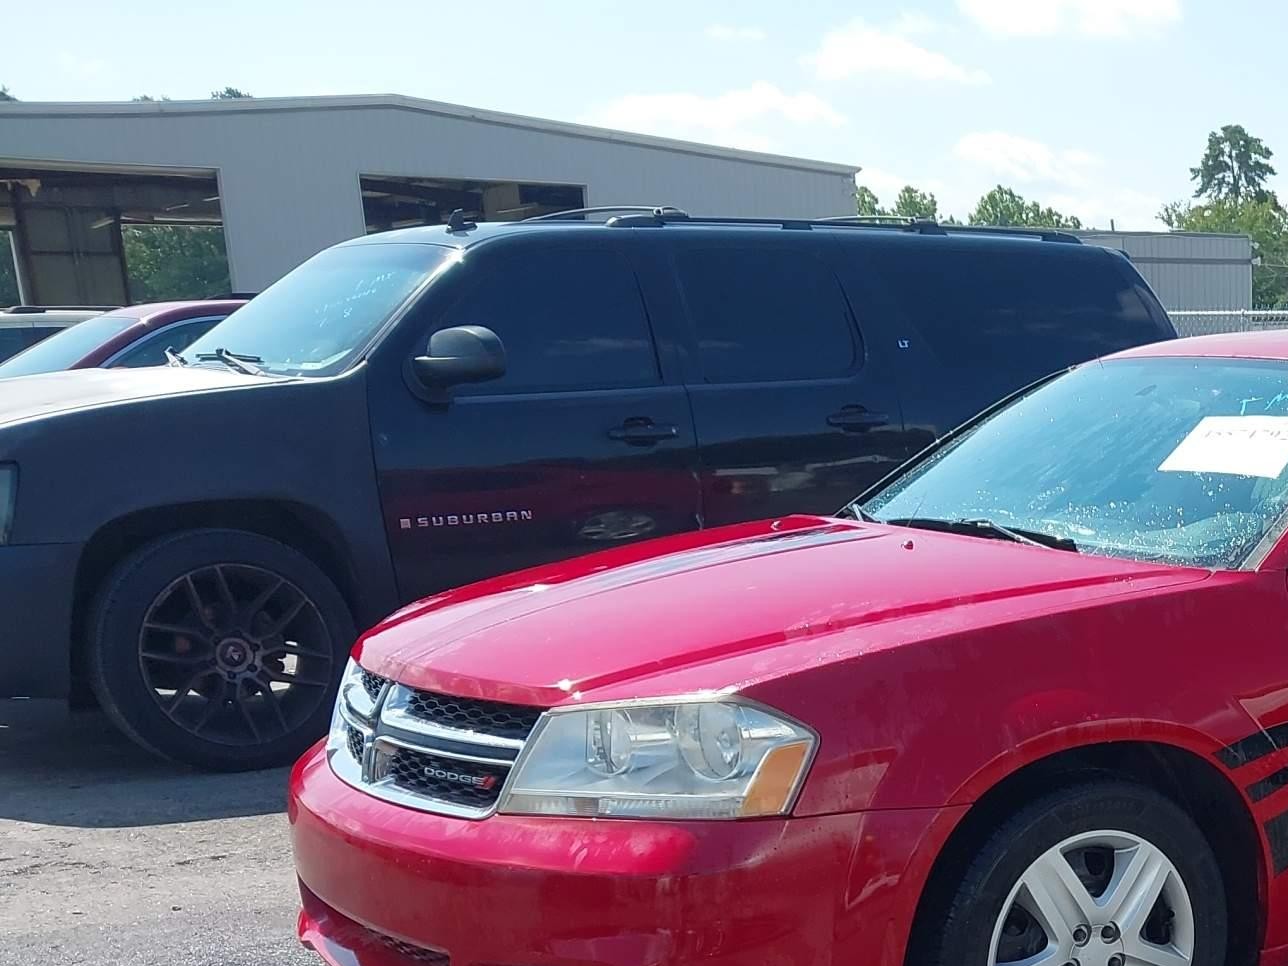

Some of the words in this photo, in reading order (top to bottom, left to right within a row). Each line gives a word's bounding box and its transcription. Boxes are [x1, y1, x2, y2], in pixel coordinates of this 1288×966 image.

[897, 339, 910, 349] LT
[417, 510, 533, 528] SUBURBAN
[423, 766, 486, 786] DODGE
